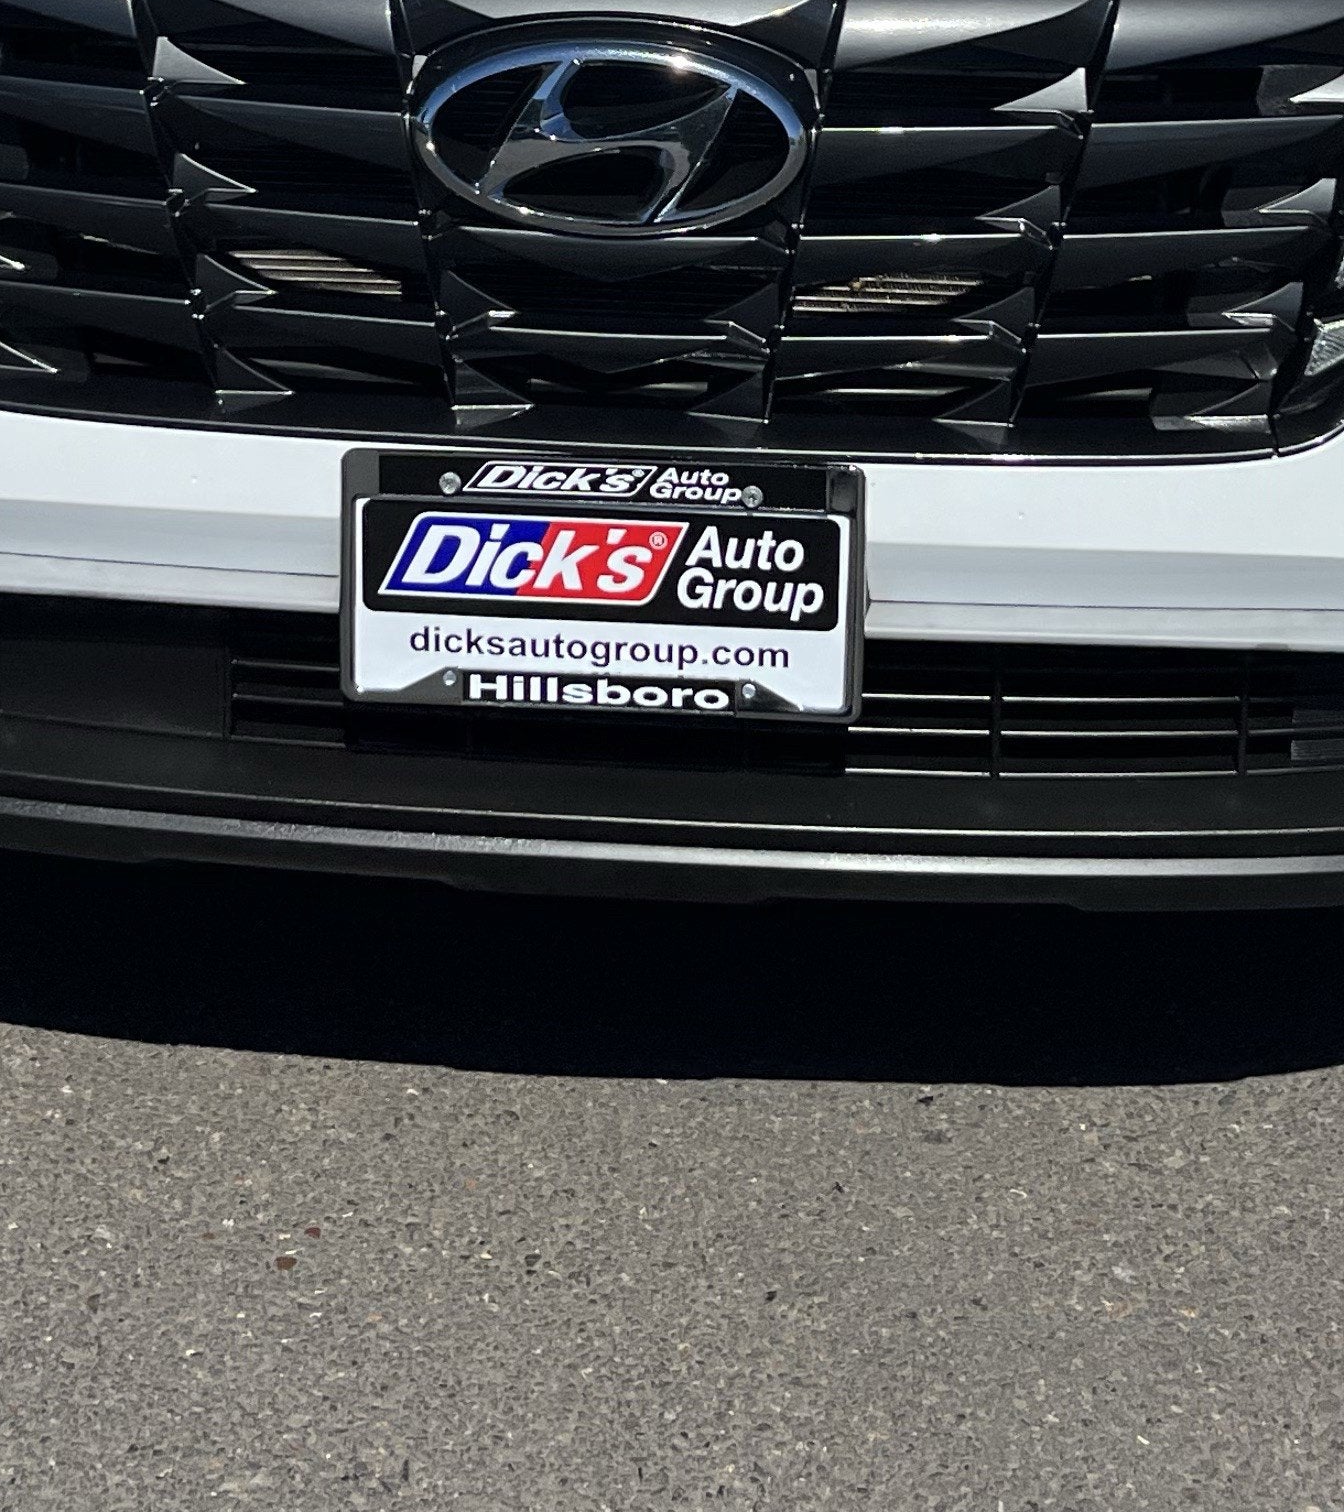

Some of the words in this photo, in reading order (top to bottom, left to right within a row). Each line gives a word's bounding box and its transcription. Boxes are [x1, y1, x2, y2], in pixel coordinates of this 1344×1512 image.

[476, 464, 636, 493] Dick's
[649, 483, 743, 504] Group
[656, 466, 730, 486] Auto
[401, 523, 653, 593] Dick's
[685, 525, 805, 572] Auto
[676, 568, 825, 622] Group
[408, 625, 791, 670] dicksautogroup.com
[467, 673, 731, 710] Hillsboro
